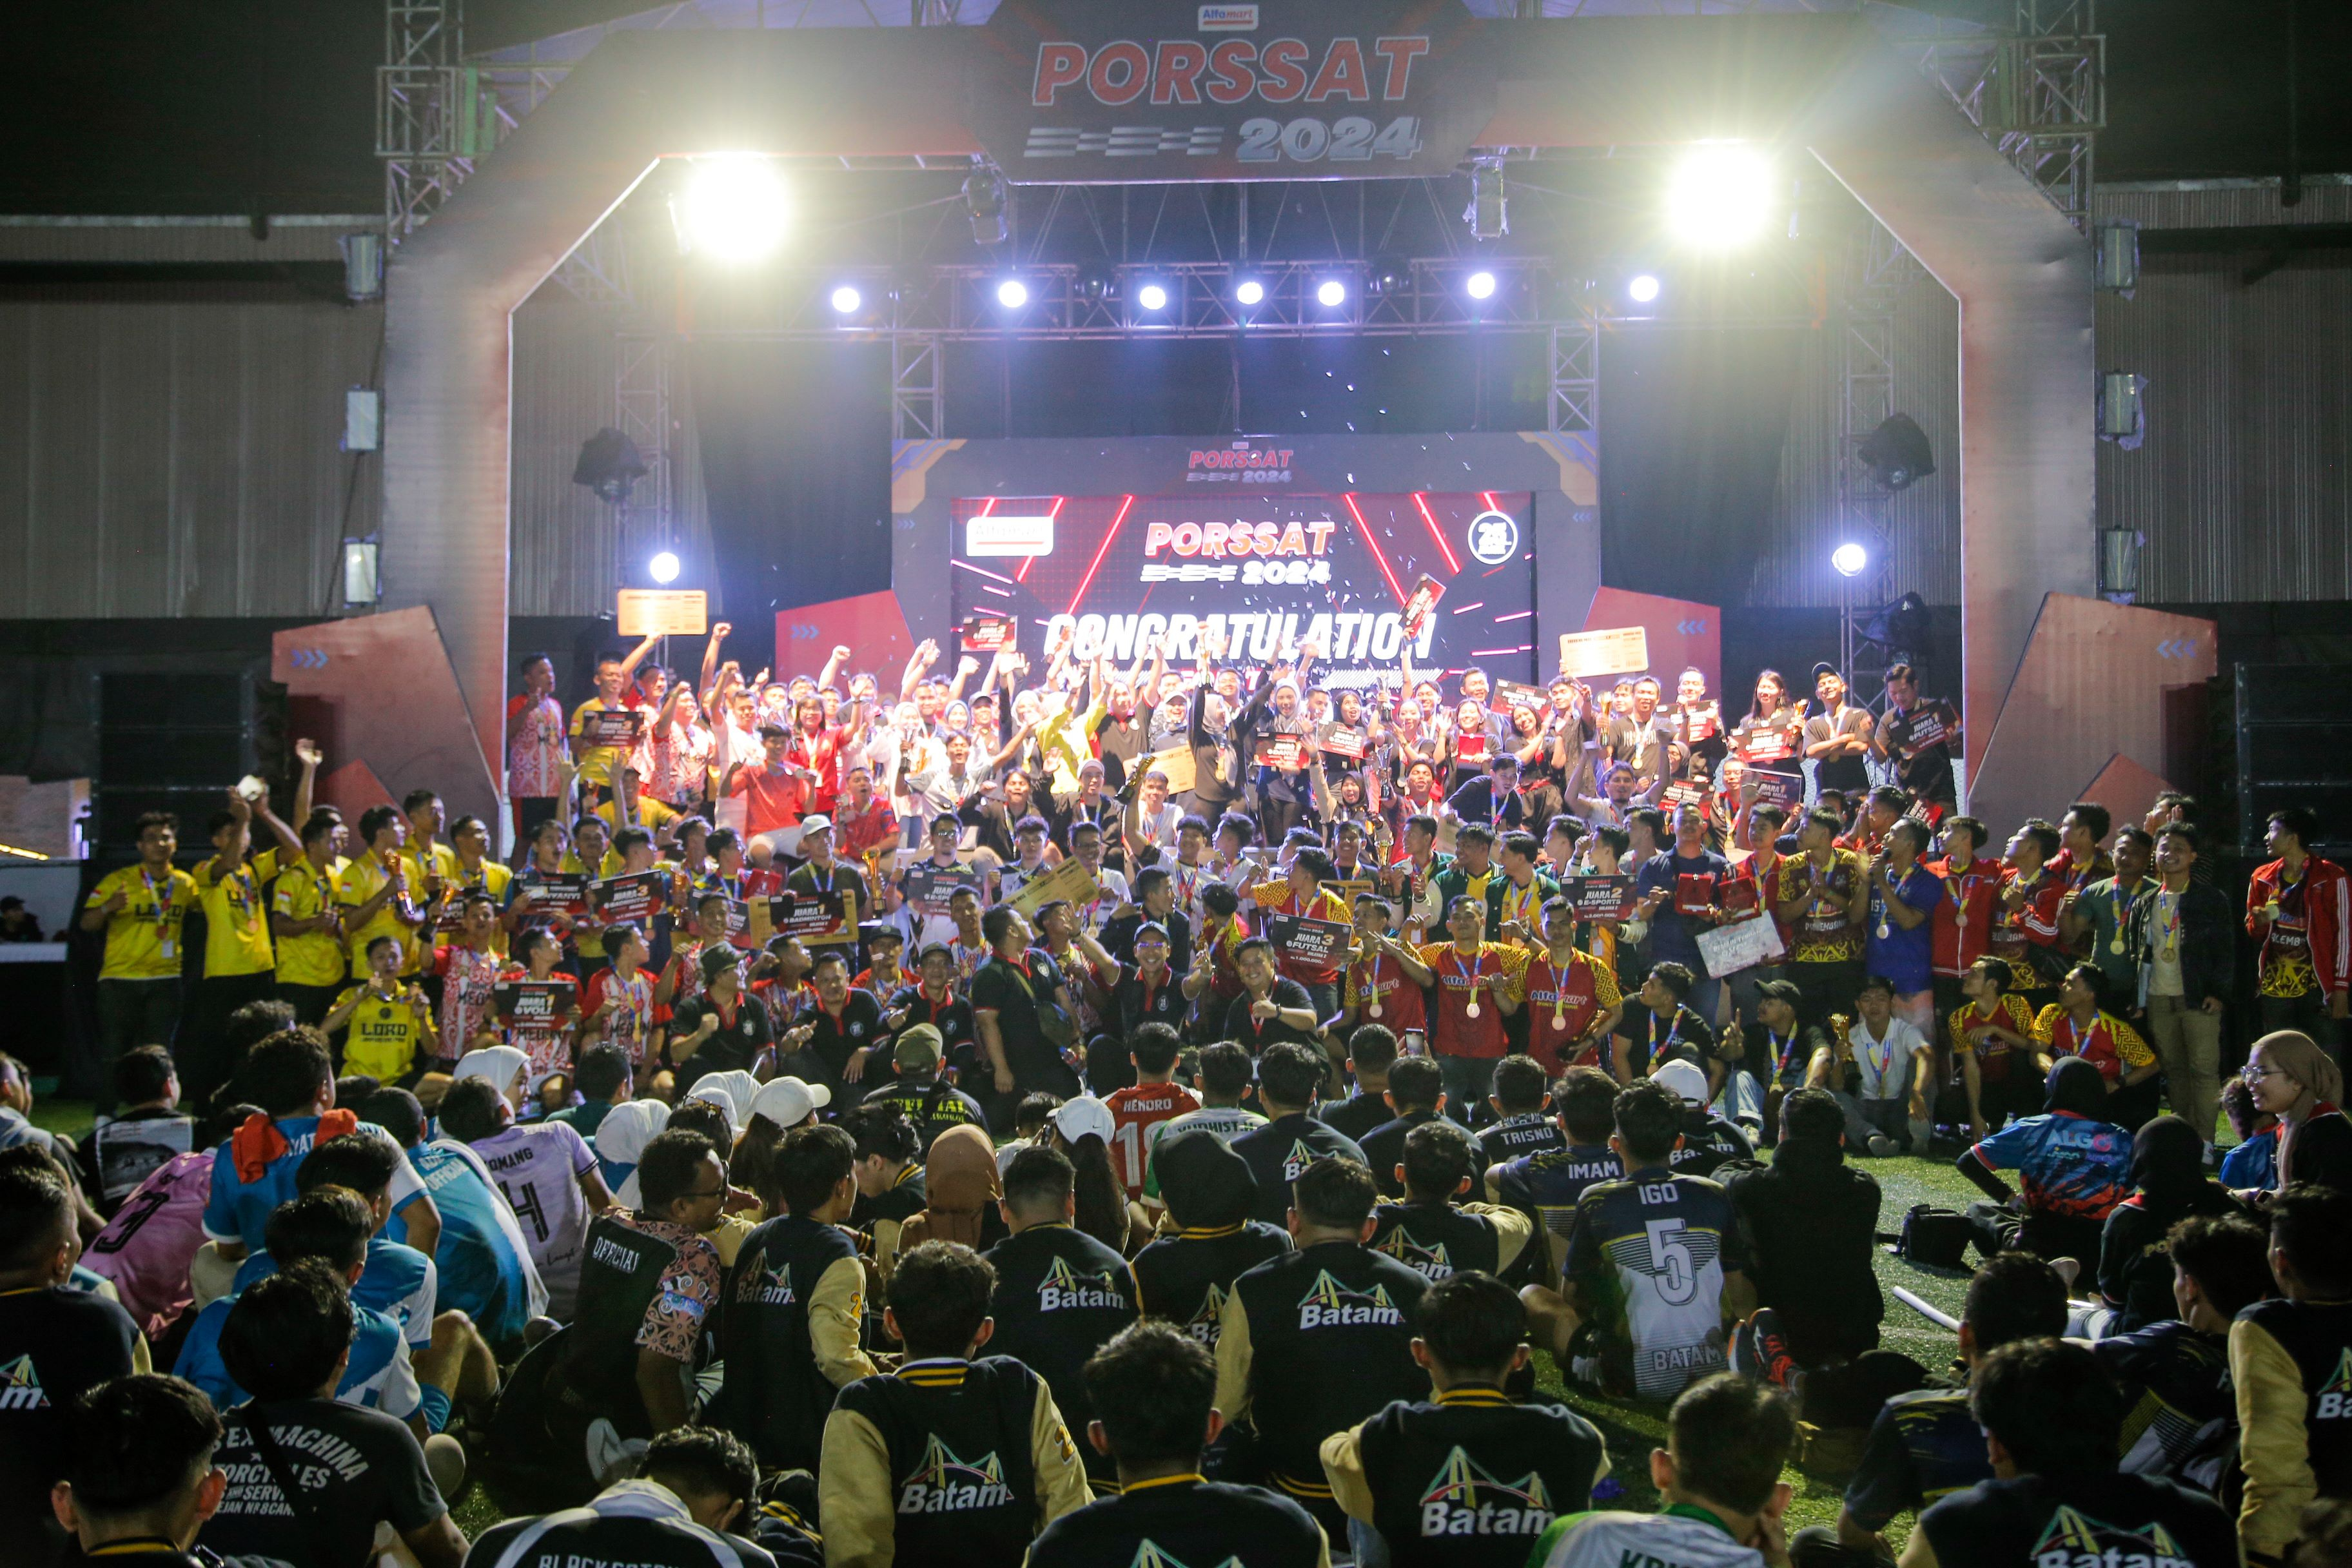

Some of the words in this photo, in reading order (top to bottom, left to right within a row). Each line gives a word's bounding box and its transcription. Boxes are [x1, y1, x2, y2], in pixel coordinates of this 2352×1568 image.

[1202, 8, 1254, 21] Alfamart
[1033, 37, 1429, 106] PORSSAT
[1235, 116, 1422, 162] 2024
[1188, 449, 1294, 469] PORSSAT
[1242, 469, 1293, 484] 2024
[1144, 521, 1335, 557] PORSSAT
[1242, 560, 1332, 586] 2024
[1043, 612, 1438, 661] CONGRATULATION
[636, 885, 650, 897] 3
[1585, 890, 1611, 899] JUARA
[1611, 887, 1623, 899] 2
[789, 914, 832, 923] BADMINTON
[794, 907, 818, 917] JUARA
[818, 903, 825, 915] 1
[1292, 942, 1329, 953] FUTSAL
[1295, 933, 1321, 945] JUARA
[1321, 934, 1335, 946] 3
[522, 1006, 552, 1015] VOLI
[546, 994, 556, 1007] 1
[362, 1023, 407, 1036] LORD
[1123, 1097, 1173, 1113] HENDRO
[1500, 1126, 1554, 1145] TRISNO
[1568, 1161, 1620, 1180] IMAM
[1638, 1182, 1679, 1205] IGO
[1645, 1217, 1698, 1306] 5
[736, 1279, 792, 1304] Batam
[1040, 1285, 1124, 1311] Batam
[1300, 1304, 1400, 1329] Batam
[1653, 1345, 1721, 1371] BATAM
[268, 1425, 369, 1482] MACHINA
[897, 1481, 1007, 1514] Batam
[1420, 1500, 1557, 1538] Batam
